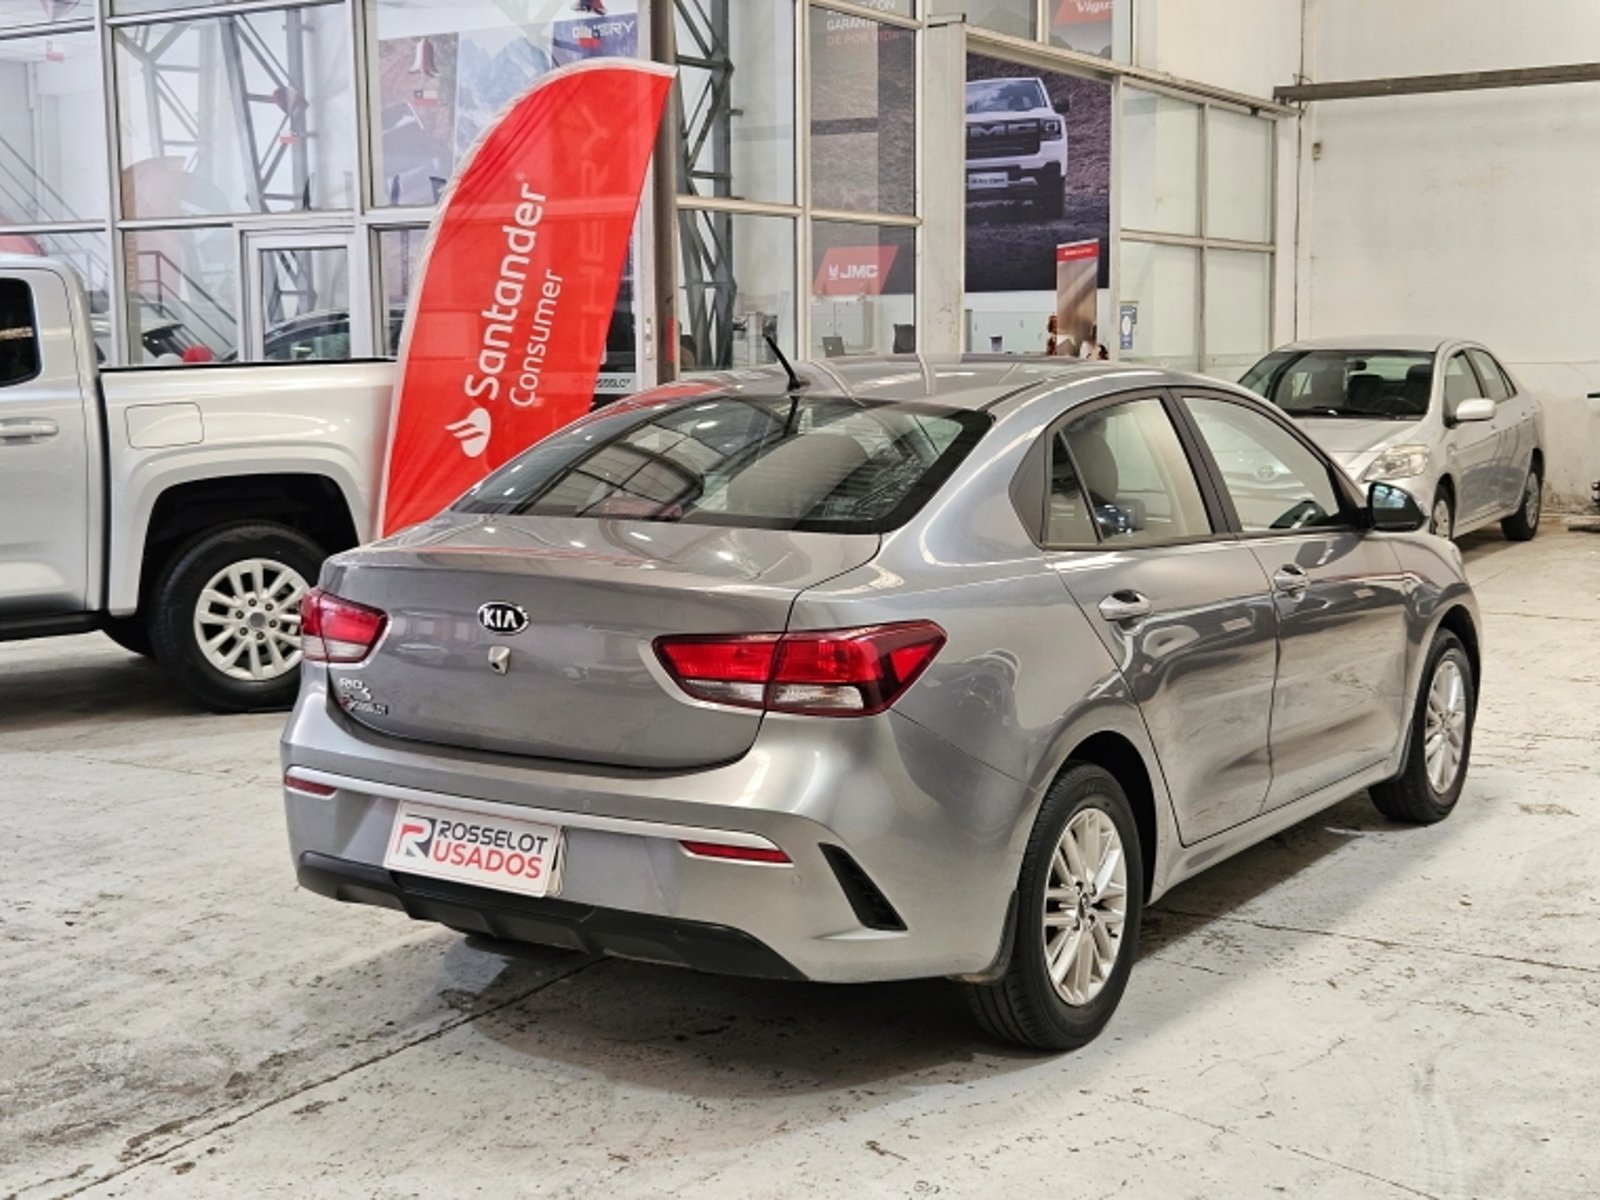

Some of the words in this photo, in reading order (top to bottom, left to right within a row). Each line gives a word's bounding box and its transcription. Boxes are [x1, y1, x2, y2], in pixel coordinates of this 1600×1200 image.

[839, 264, 879, 279] JMC
[464, 182, 547, 401] Santander
[509, 269, 564, 408] Consumer
[483, 607, 519, 628] KIA
[437, 819, 549, 855] ROSSELOT
[432, 839, 543, 880] USADOS
